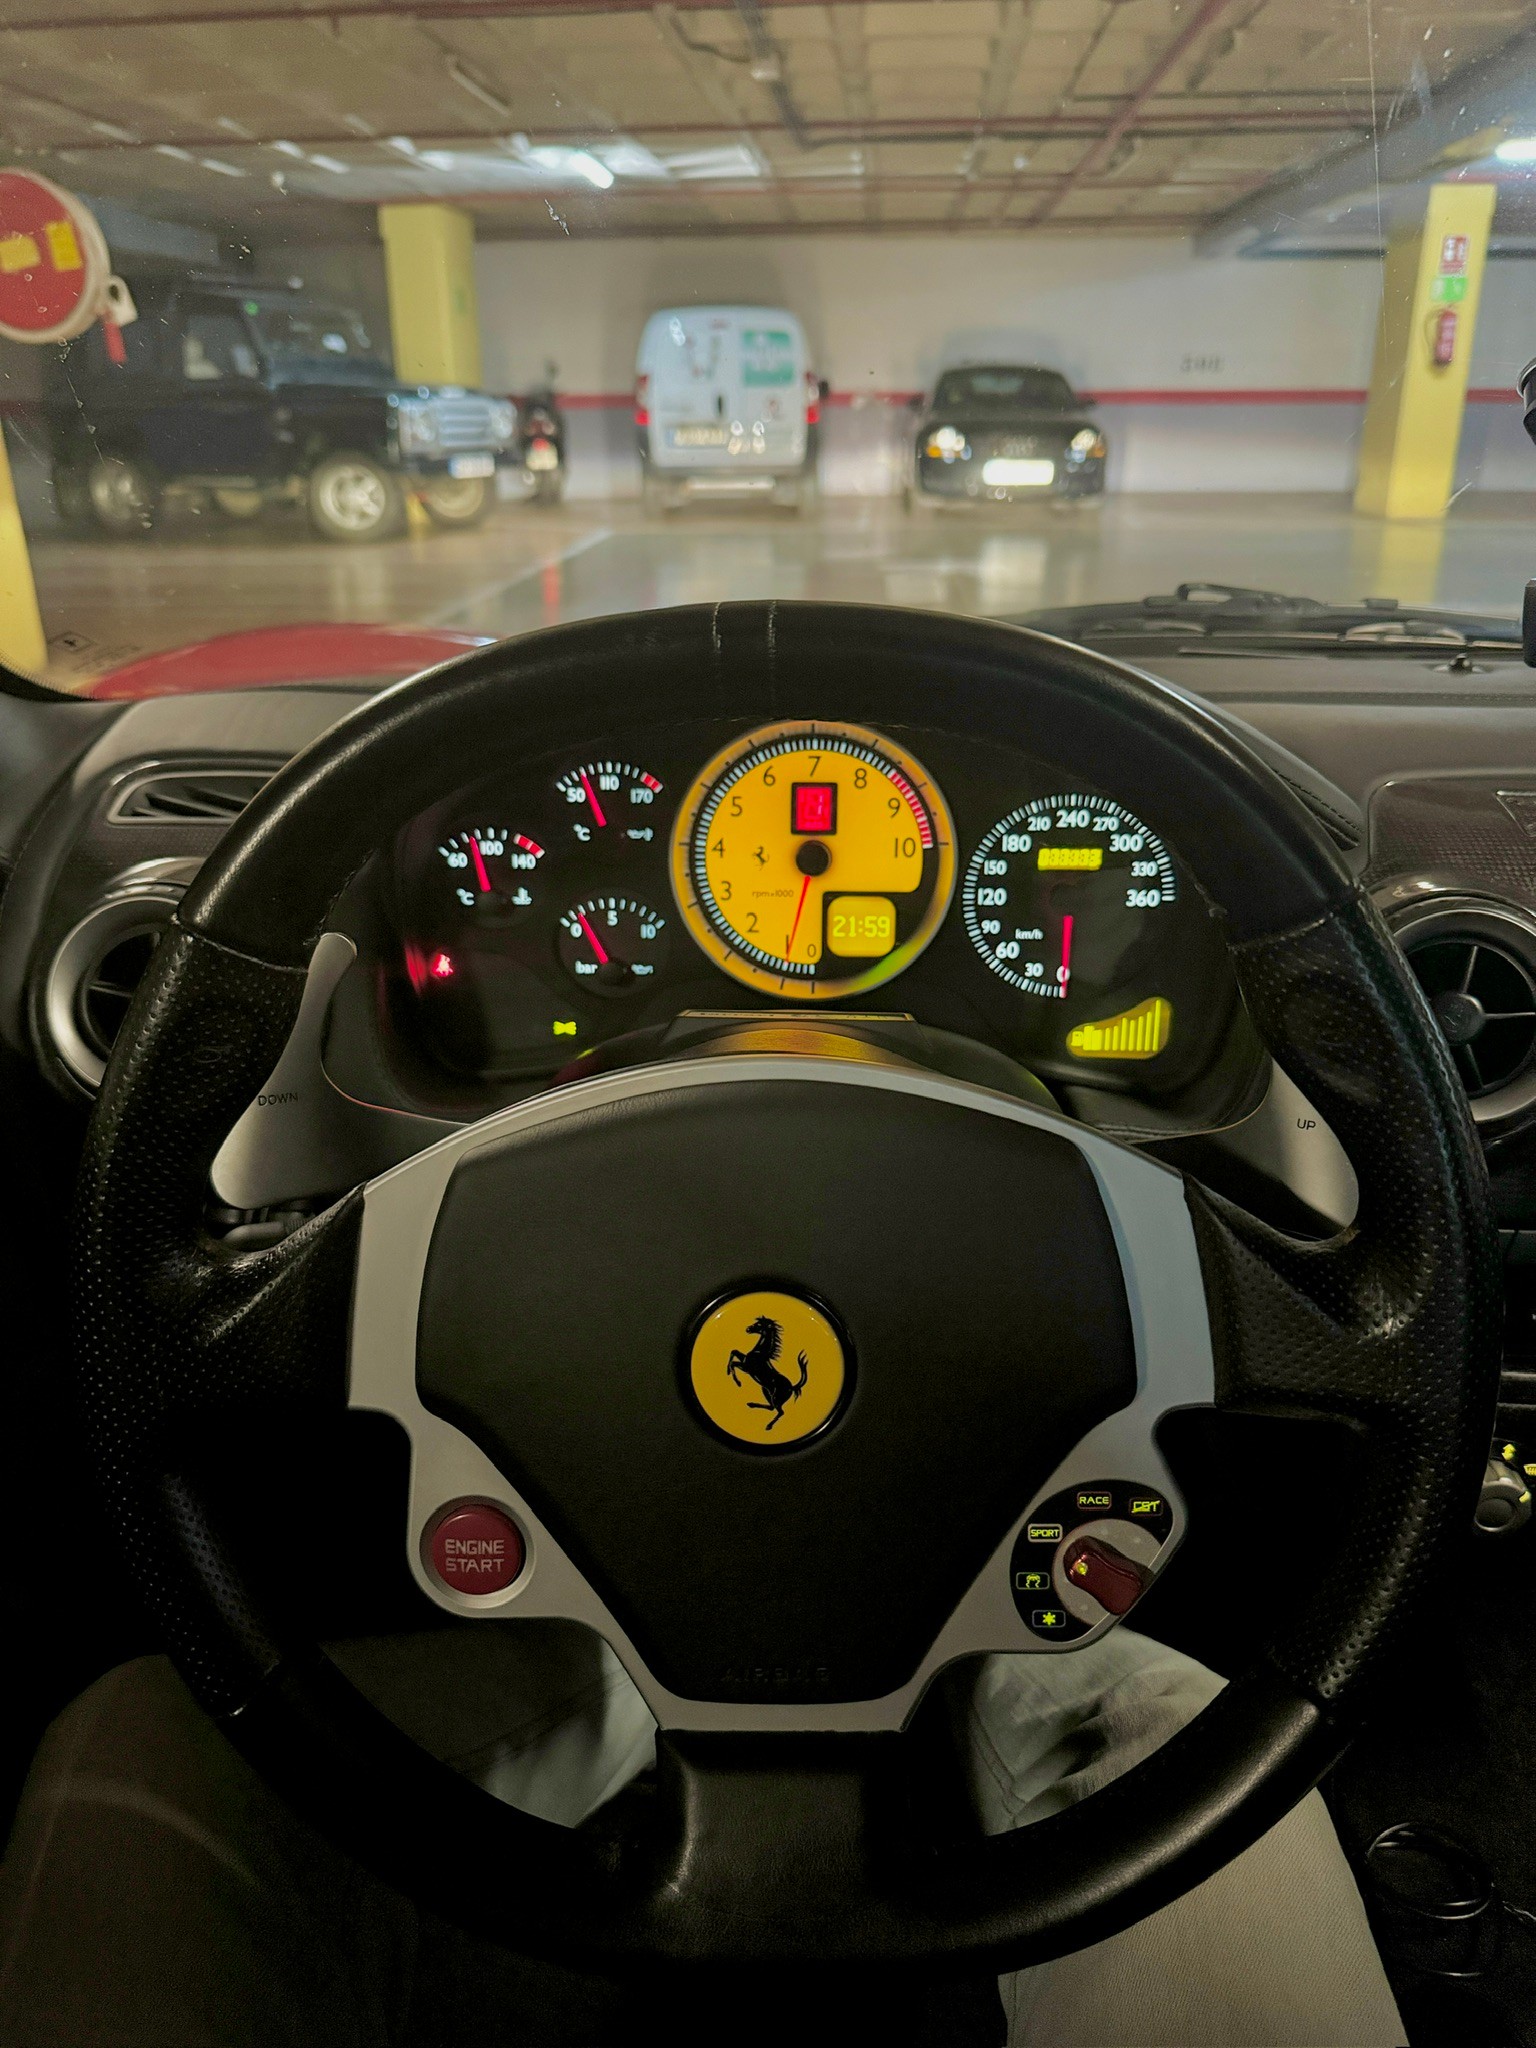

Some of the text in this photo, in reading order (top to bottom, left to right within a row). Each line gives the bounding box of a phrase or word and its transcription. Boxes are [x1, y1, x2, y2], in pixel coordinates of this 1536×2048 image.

[808, 756, 821, 776] 7
[599, 774, 619, 791] 110
[763, 766, 776, 786] 6
[854, 768, 867, 789] 8
[566, 786, 586, 803] 50
[630, 787, 654, 804] 170
[730, 796, 743, 818] 5
[888, 798, 901, 818] 9
[1027, 816, 1051, 831] 210
[1056, 809, 1090, 828] 240
[1092, 816, 1119, 831] 270
[479, 840, 504, 856] 100
[711, 838, 726, 858] 4
[894, 838, 917, 859] 10
[1002, 834, 1032, 852] 180
[1109, 834, 1143, 852] 300
[447, 853, 468, 868] 60
[511, 853, 536, 869] 140
[983, 860, 1008, 876] 150
[1131, 861, 1158, 877] 330
[720, 881, 733, 901] 3
[977, 888, 1008, 906] 120
[1125, 889, 1161, 907] 360
[607, 910, 618, 926] 5
[746, 913, 760, 933] 2
[570, 922, 583, 938] 0
[640, 923, 657, 939] 10
[832, 915, 891, 938] 21:59
[981, 919, 1001, 935] 90
[1015, 929, 1043, 940] km/h
[806, 944, 817, 958] 0
[995, 941, 1021, 959] 60
[575, 961, 598, 975] bar
[1024, 962, 1044, 977] 30
[258, 1092, 299, 1106] DOWN
[1296, 1118, 1317, 1131] UP
[1079, 1496, 1110, 1505] RACE
[1030, 1529, 1060, 1538] SPORT
[445, 1539, 505, 1555] ENGINE
[446, 1558, 505, 1573] START
